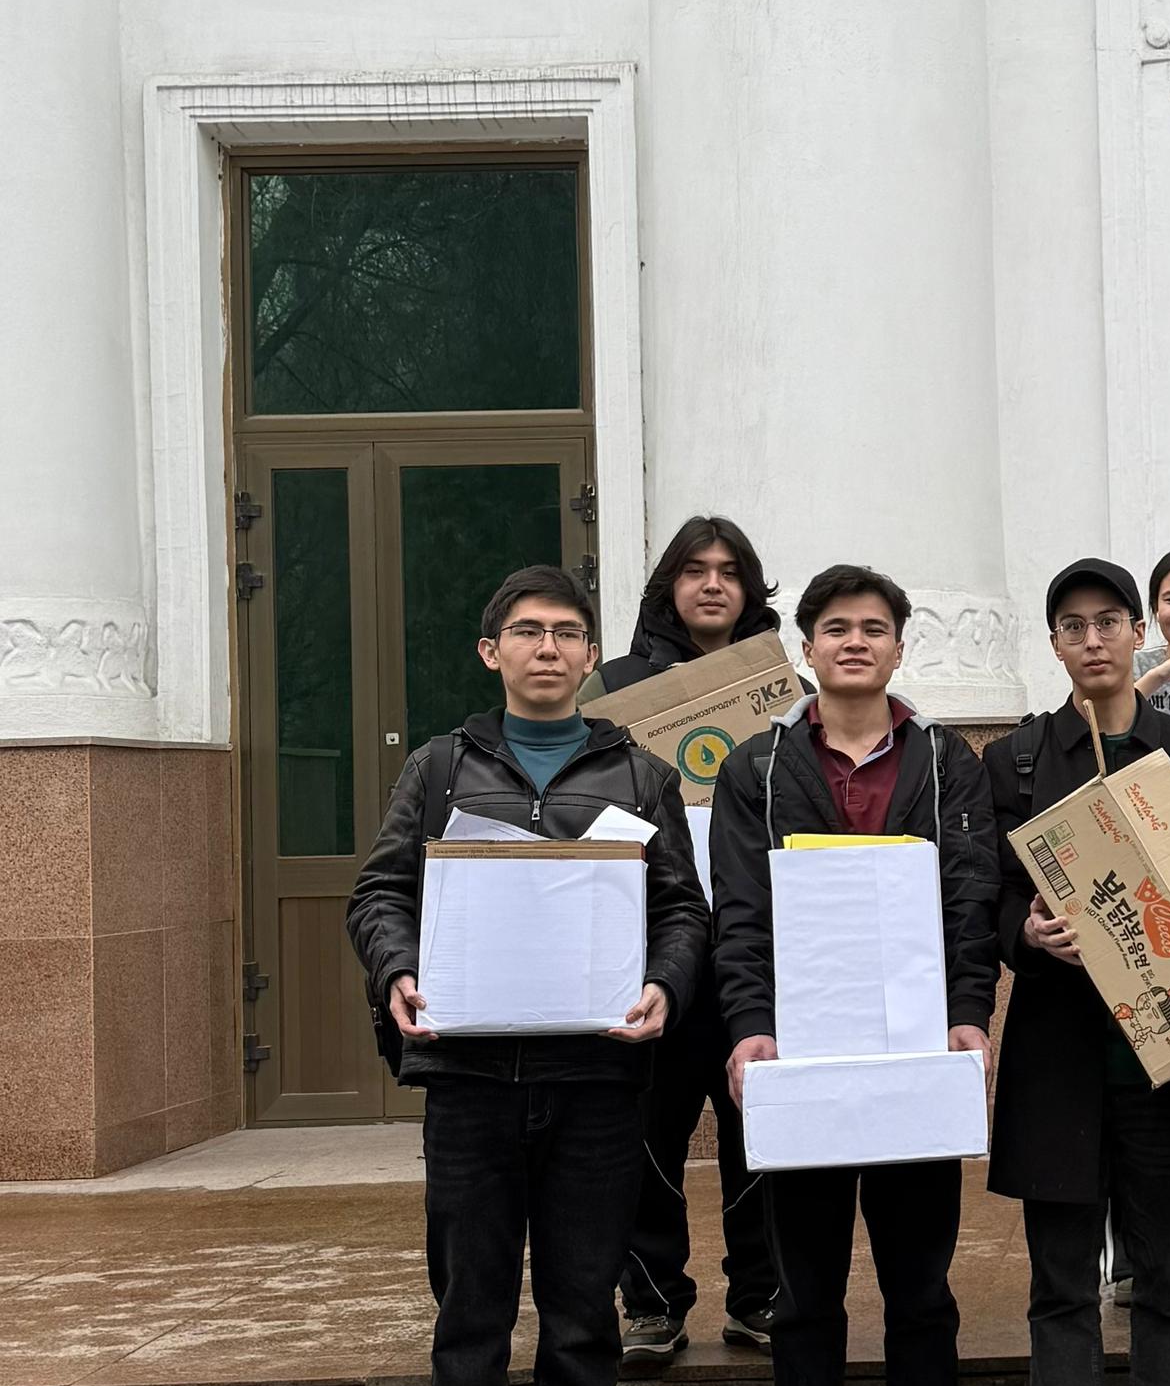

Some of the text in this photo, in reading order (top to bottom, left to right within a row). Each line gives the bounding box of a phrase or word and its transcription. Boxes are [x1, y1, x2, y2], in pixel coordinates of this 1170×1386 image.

[760, 677, 793, 702] KZ
[1093, 799, 1123, 844] SAMYANG
[1129, 783, 1162, 831] SAMYANG
[1090, 869, 1151, 970] 불닭볶음면
